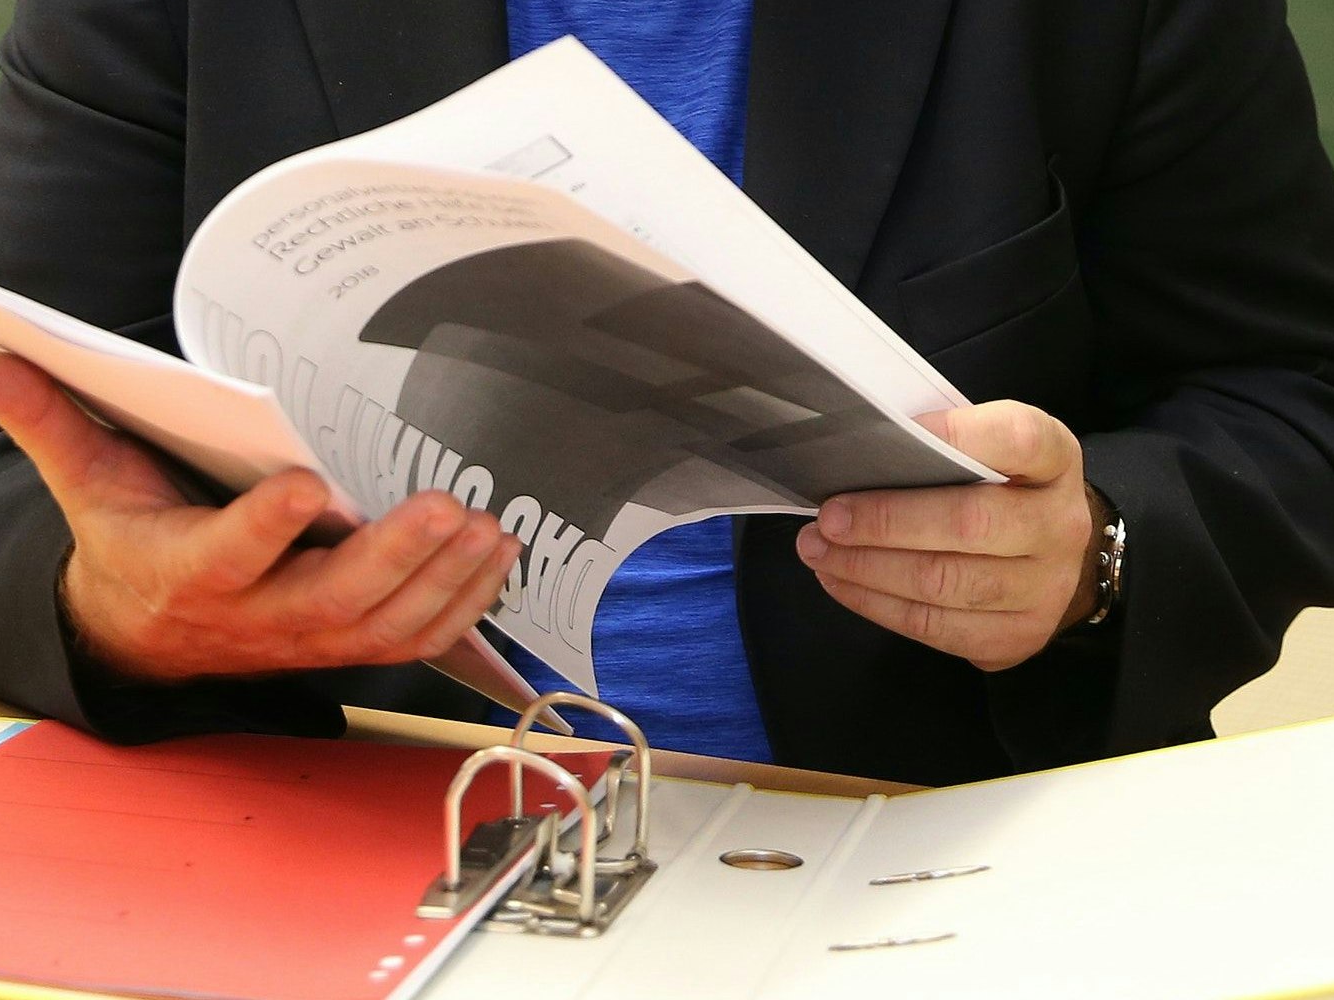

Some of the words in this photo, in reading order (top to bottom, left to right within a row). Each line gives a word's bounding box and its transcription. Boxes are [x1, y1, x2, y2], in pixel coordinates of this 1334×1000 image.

[269, 199, 413, 262] Rechtliche
[294, 223, 391, 275] Gewalt
[396, 216, 436, 231] an
[328, 264, 380, 299] 2018
[499, 494, 617, 655] DAS
